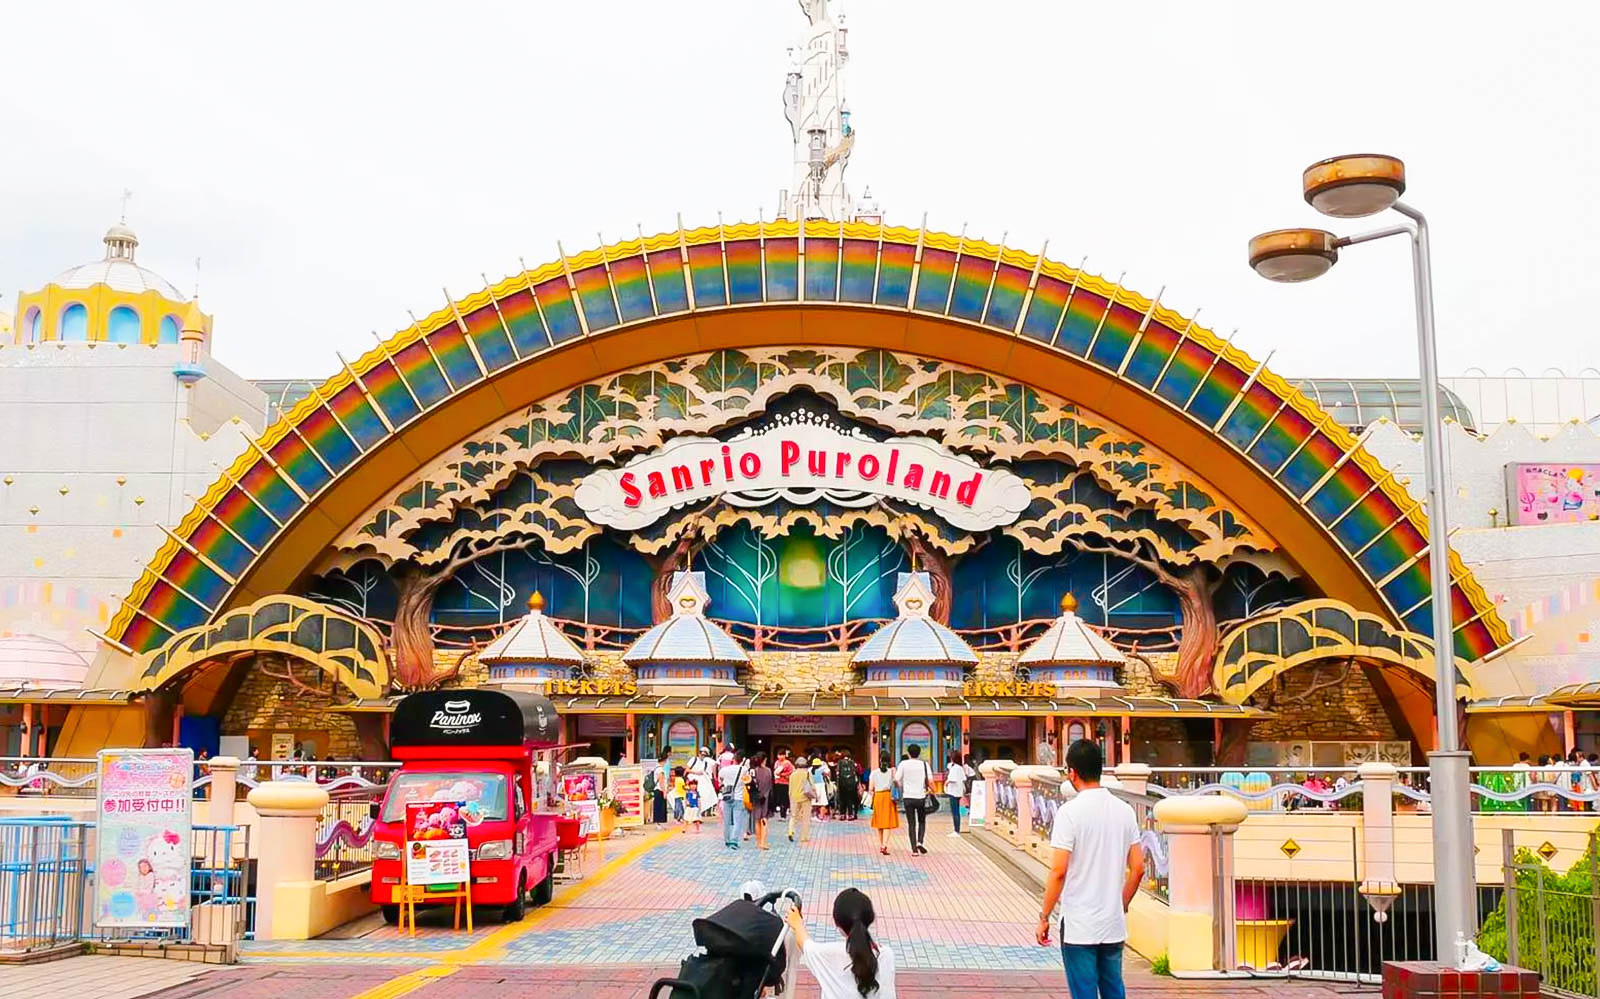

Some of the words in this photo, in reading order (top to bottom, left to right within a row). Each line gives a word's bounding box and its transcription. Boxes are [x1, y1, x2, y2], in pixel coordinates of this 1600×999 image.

[619, 446, 762, 507] Sanrio
[780, 440, 984, 508] Puroland
[544, 679, 638, 695] TICKETS
[963, 681, 1057, 697] TICKETS
[430, 710, 482, 726] Paninox
